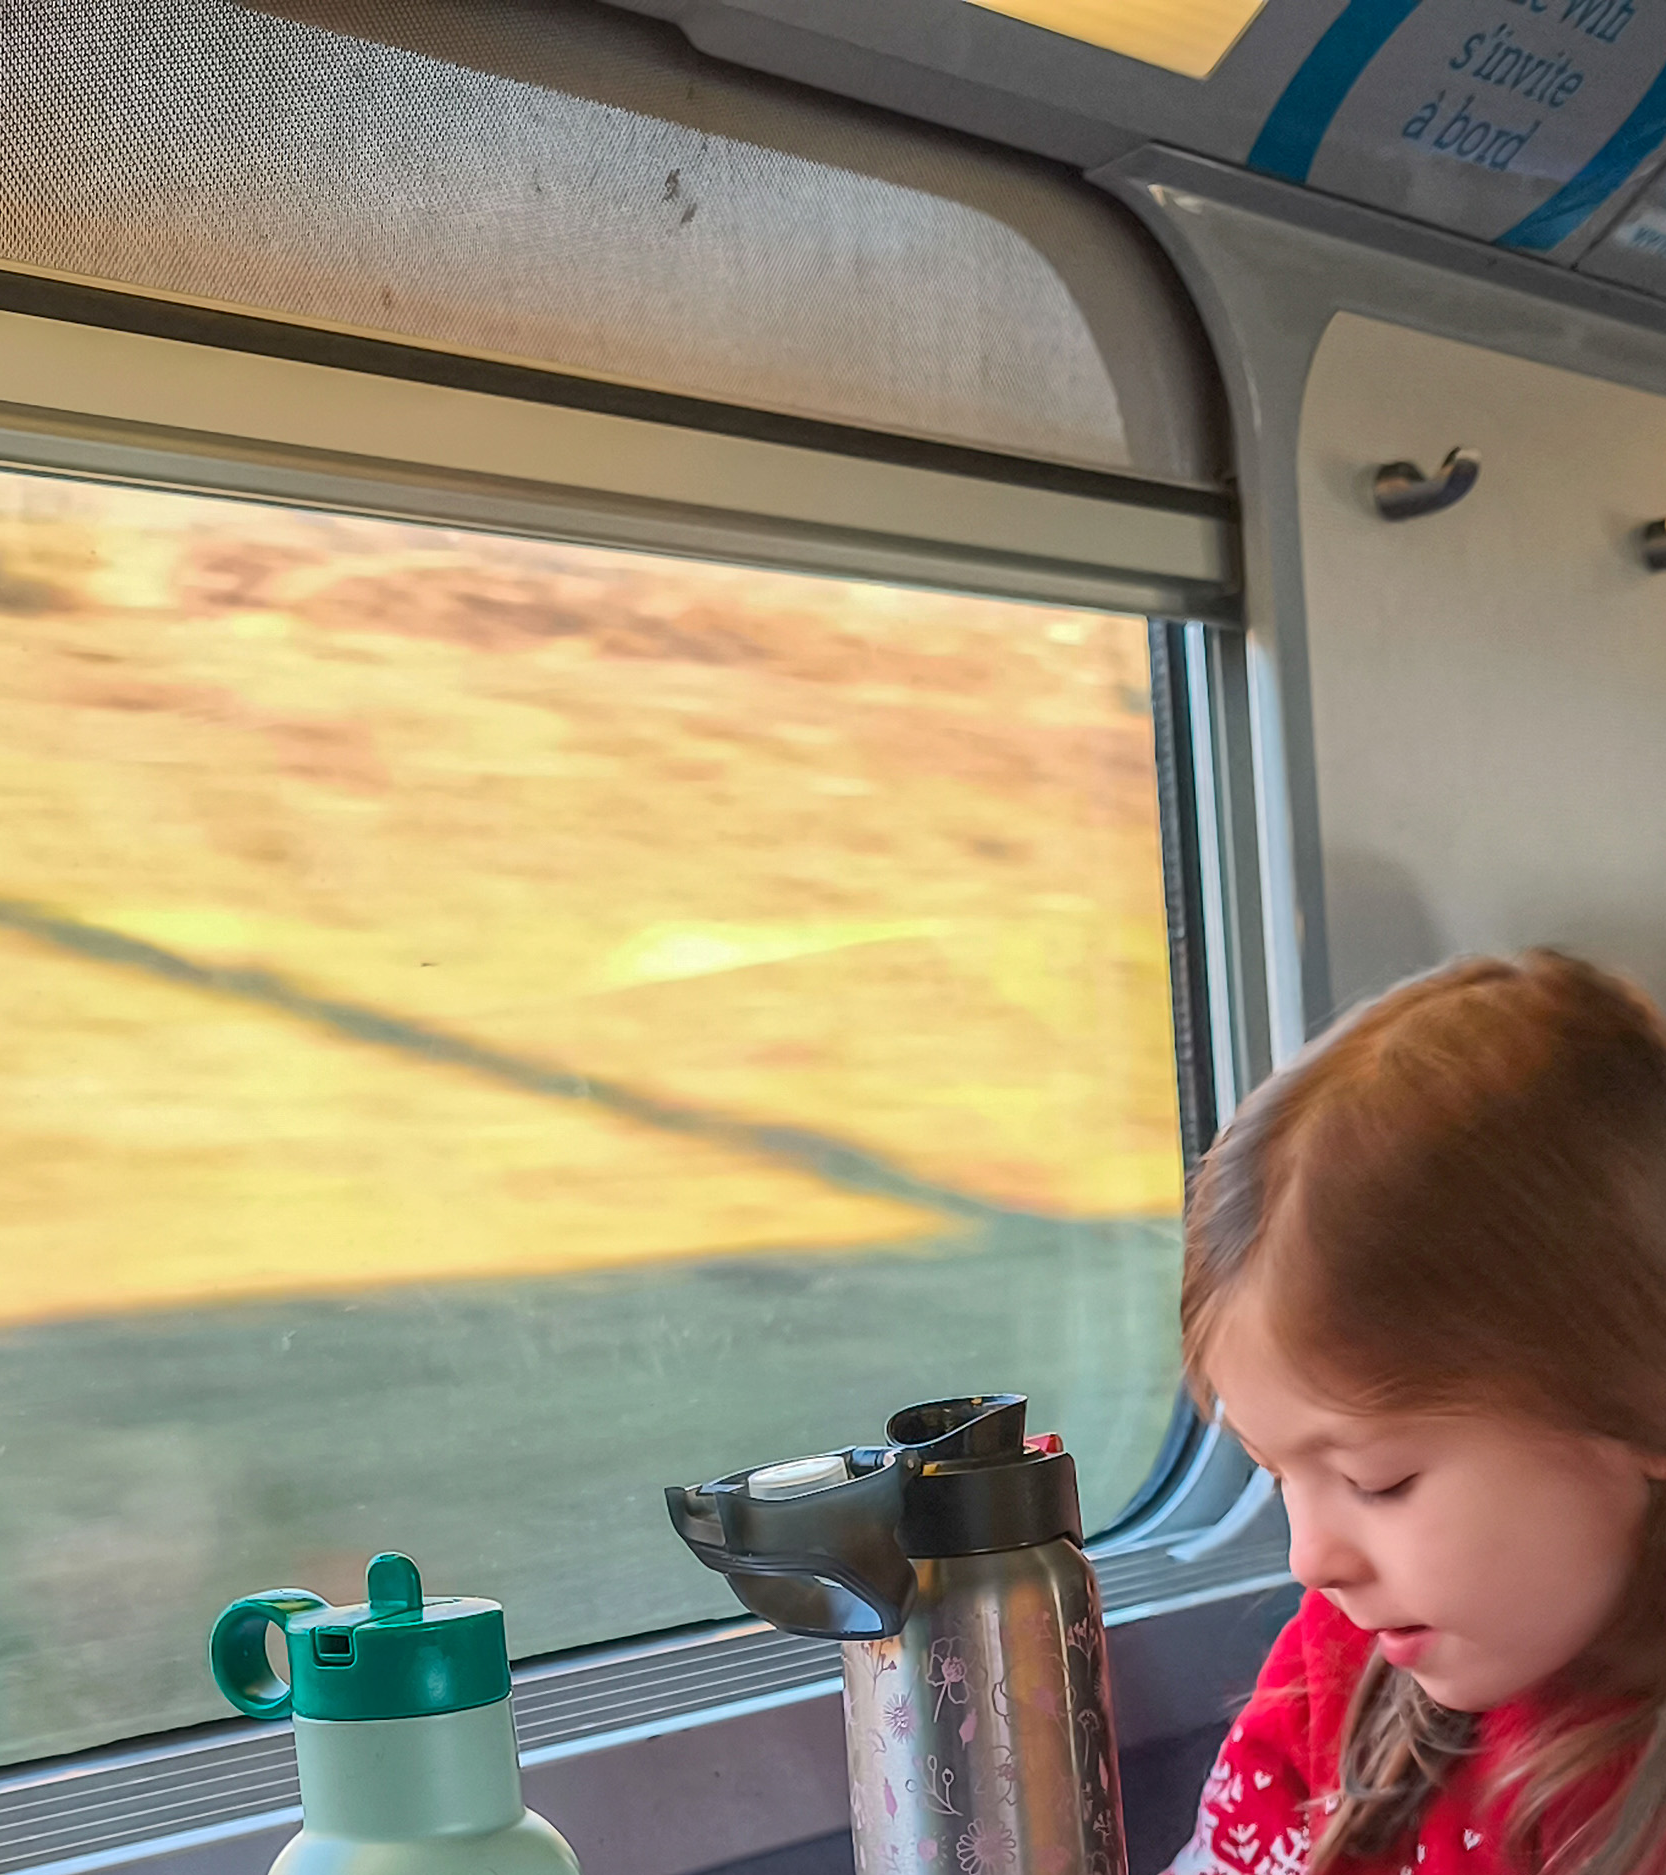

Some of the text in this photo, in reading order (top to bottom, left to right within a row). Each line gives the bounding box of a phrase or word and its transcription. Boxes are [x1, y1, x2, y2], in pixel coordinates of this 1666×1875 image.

[1448, 22, 1583, 108] s'invite
[1402, 89, 1542, 171] à bord
